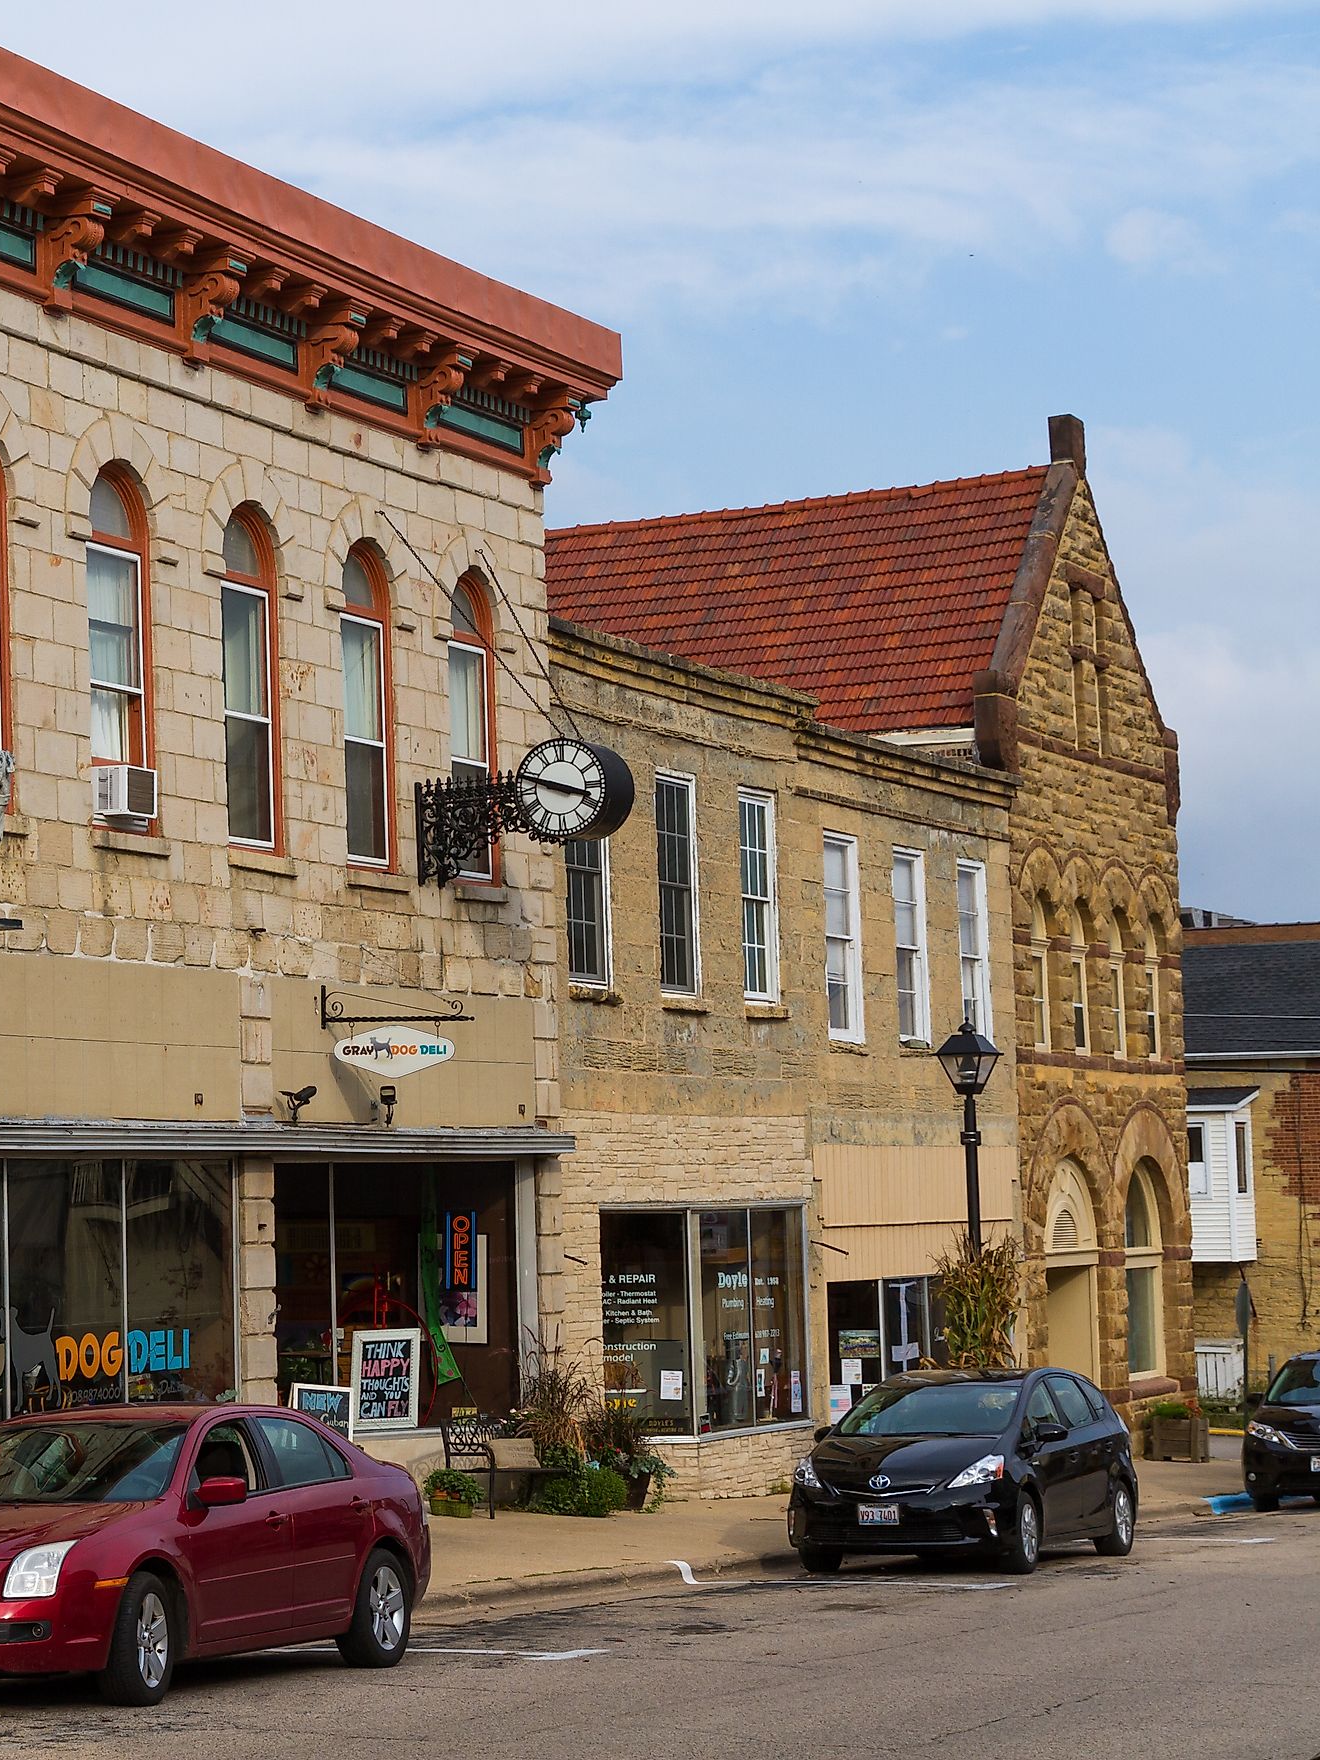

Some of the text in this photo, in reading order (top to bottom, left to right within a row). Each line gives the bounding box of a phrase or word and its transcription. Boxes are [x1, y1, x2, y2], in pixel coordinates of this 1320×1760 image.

[342, 1044, 447, 1056] GRAY DOG DELI
[452, 1215, 471, 1285] OPEN
[608, 1274, 656, 1284] & REPAIR
[717, 1271, 749, 1291] Doyle
[721, 1297, 745, 1310] Plumbing
[755, 1296, 775, 1309] Heating
[614, 1317, 635, 1325] Septic
[365, 1341, 408, 1359] THINK
[602, 1341, 657, 1351] onstruction
[55, 1331, 123, 1382] DOG
[127, 1328, 191, 1374] DELI
[603, 1353, 634, 1362] model
[361, 1358, 411, 1378] HAPPY
[361, 1376, 410, 1392] THOUGHTS
[301, 1391, 344, 1414] NEW
[361, 1390, 402, 1401] AND YOU
[360, 1401, 386, 1418] CAN
[604, 1397, 638, 1411] oyle
[320, 1413, 350, 1429] Cuban
